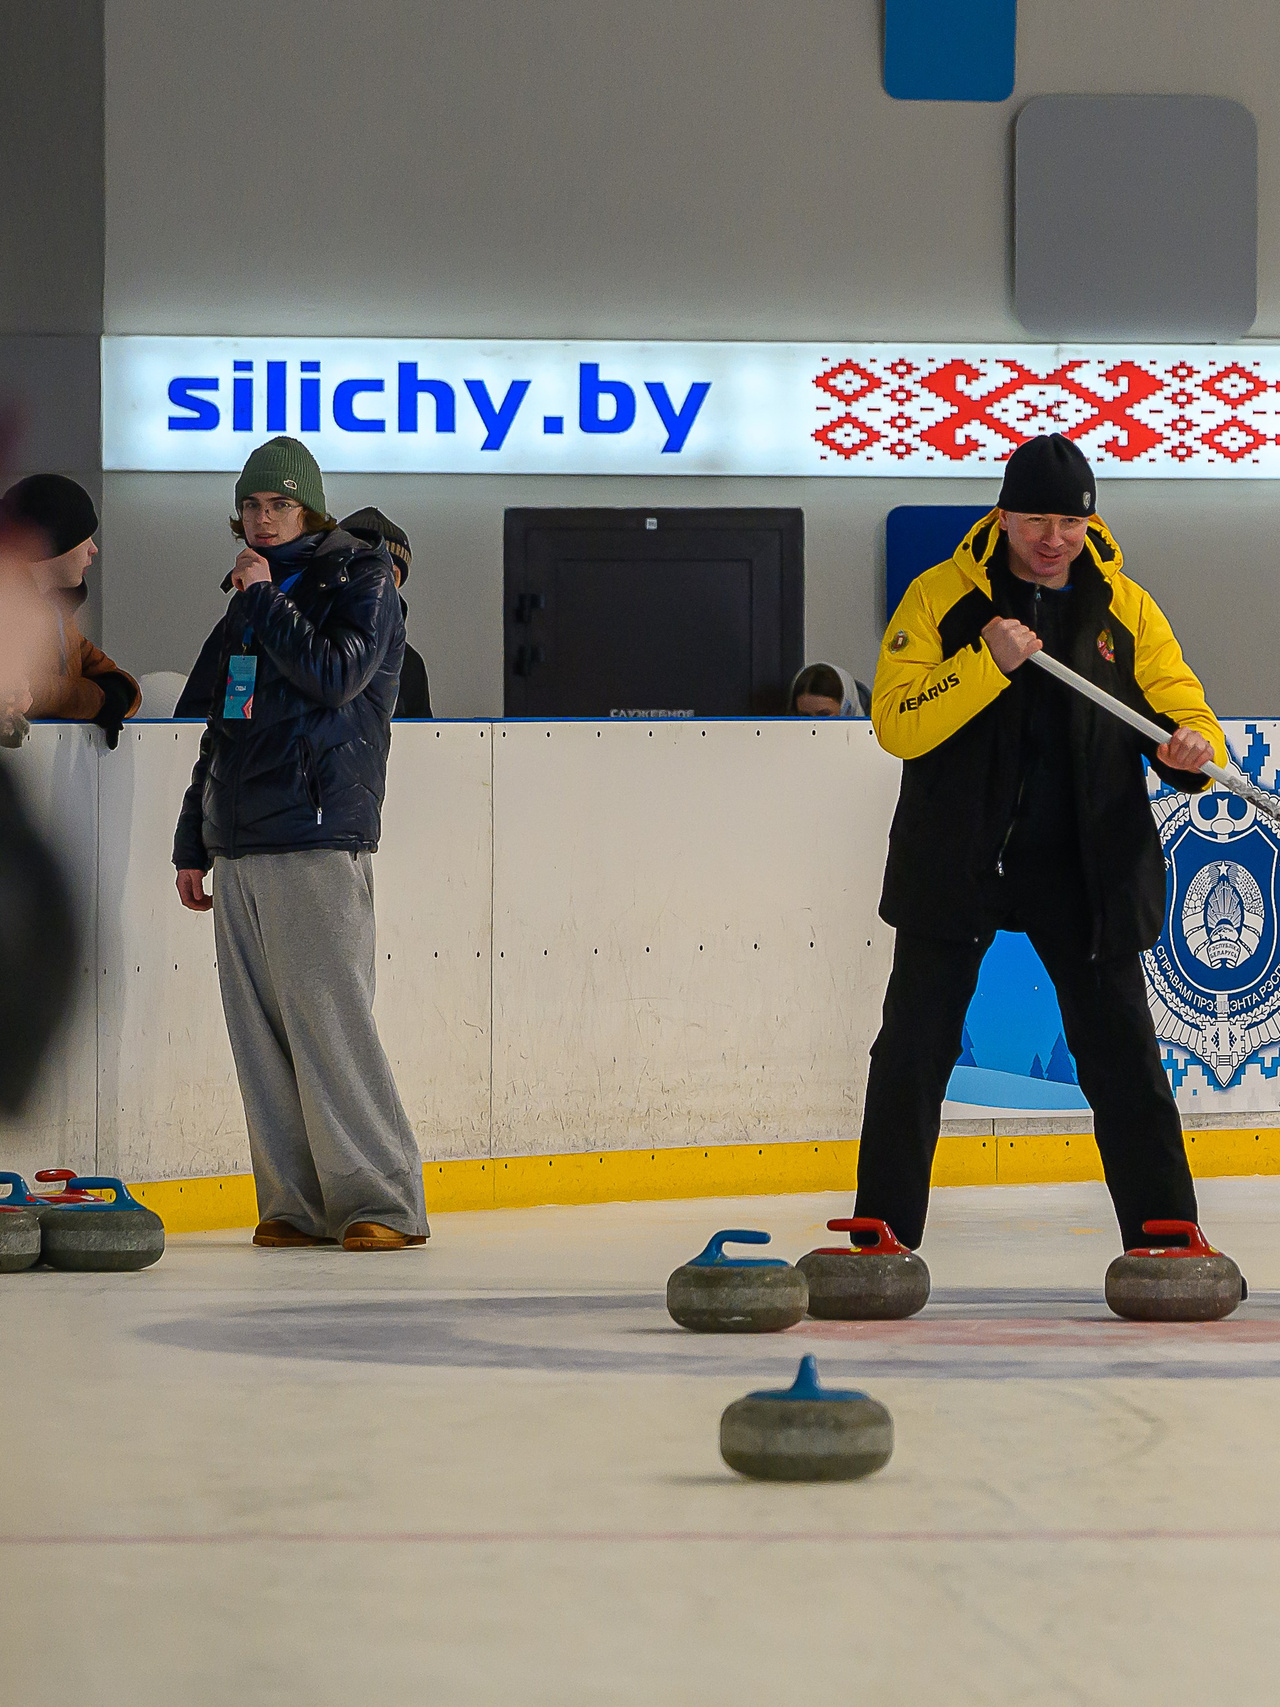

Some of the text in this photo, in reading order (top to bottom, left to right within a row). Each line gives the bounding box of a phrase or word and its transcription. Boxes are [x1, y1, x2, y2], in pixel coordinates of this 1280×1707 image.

[167, 360, 713, 454] silichy.by
[1156, 945, 1194, 1002] СПРАВАМІ
[1193, 992, 1261, 1015] ПРЭЗЭНТА
